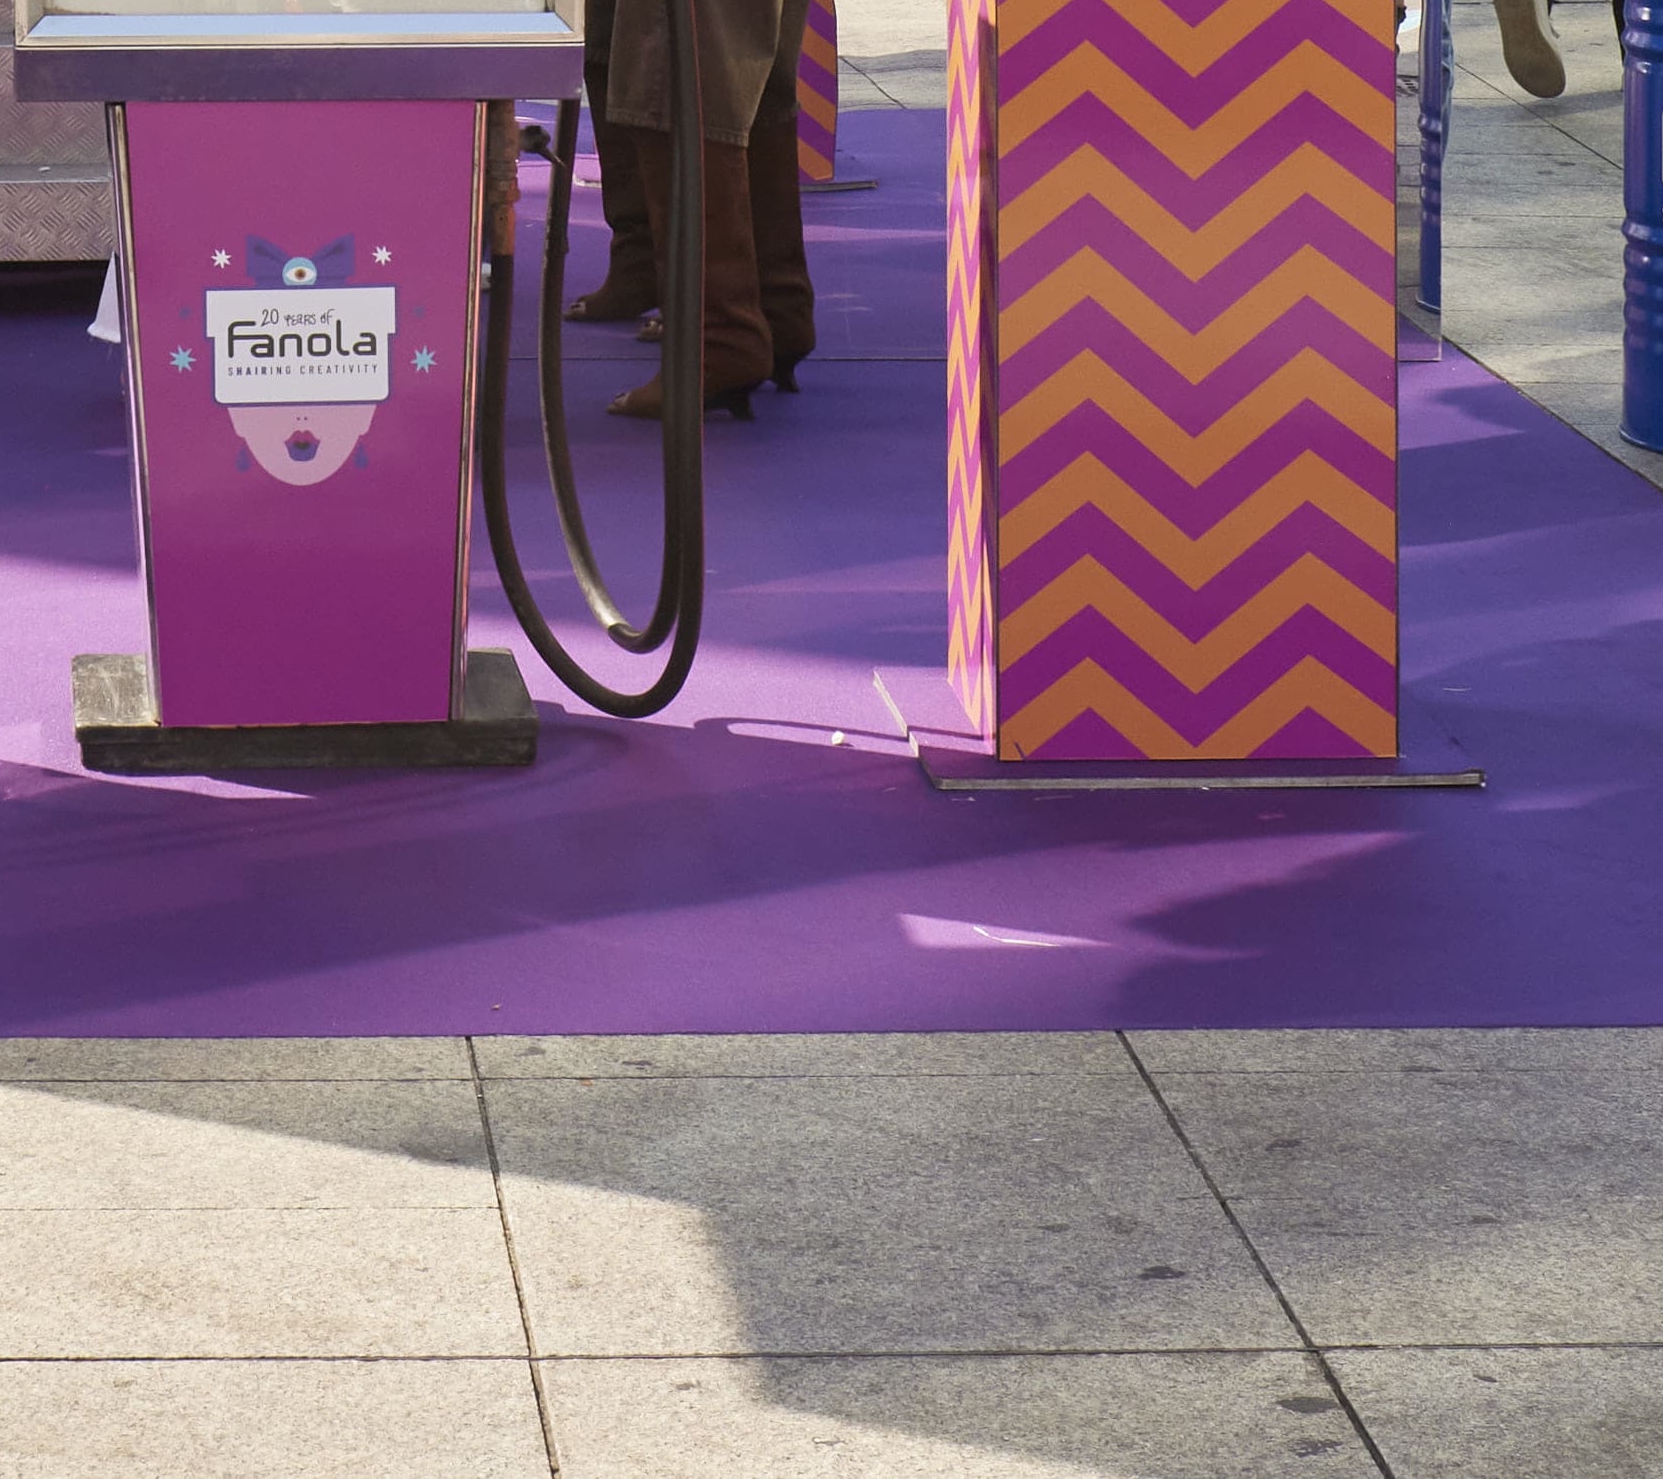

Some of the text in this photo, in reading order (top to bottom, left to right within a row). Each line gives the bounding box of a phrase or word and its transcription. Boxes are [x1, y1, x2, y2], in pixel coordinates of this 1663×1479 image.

[259, 308, 281, 327] 20
[226, 318, 378, 360] Fanola
[226, 362, 379, 377] SHAIRING CREATIVITY
